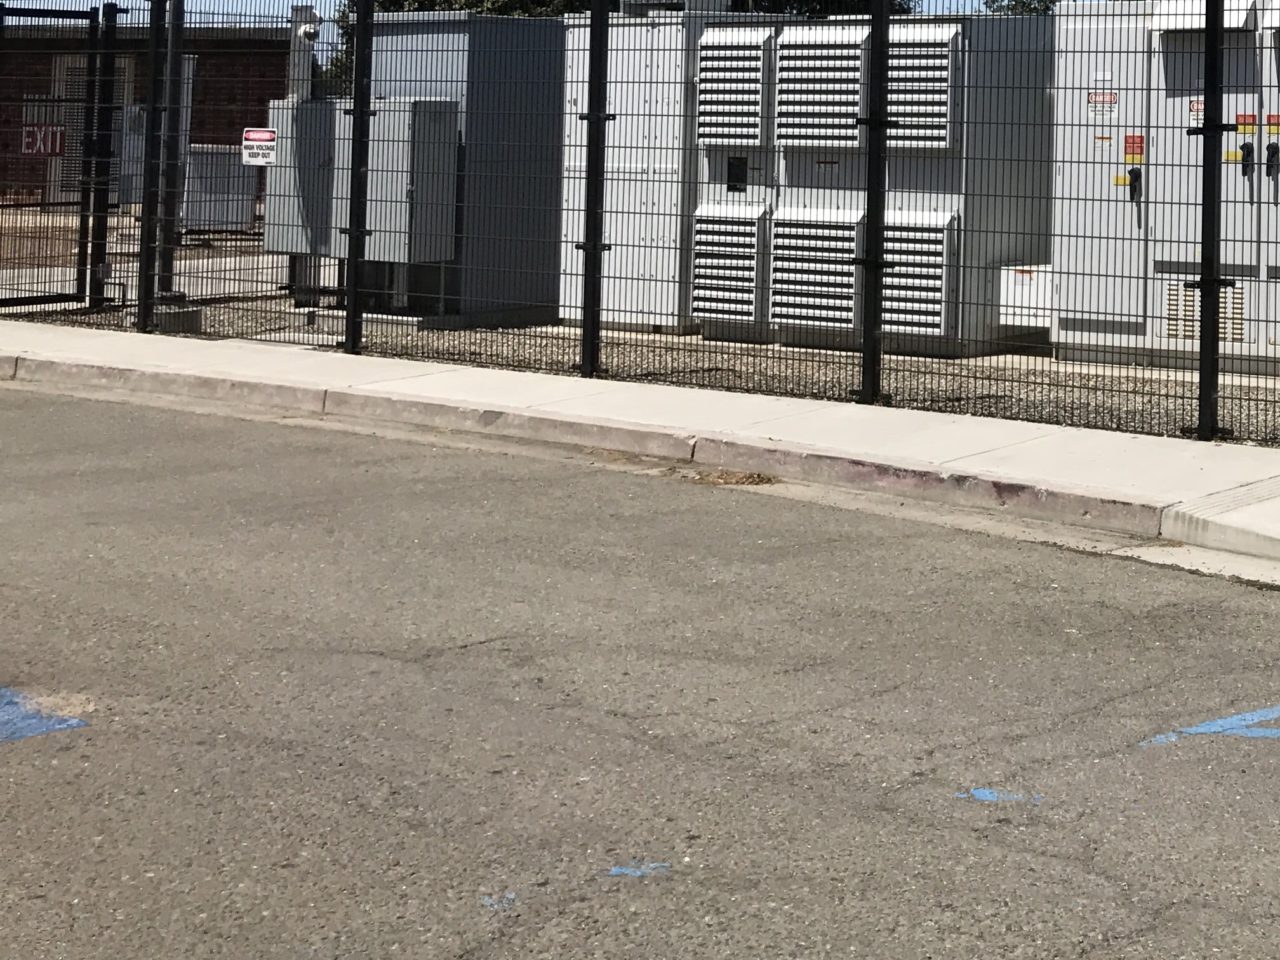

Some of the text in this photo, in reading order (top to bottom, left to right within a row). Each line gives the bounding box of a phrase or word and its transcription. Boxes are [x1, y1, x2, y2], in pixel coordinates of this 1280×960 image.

[22, 126, 65, 153] EXIT
[255, 144, 276, 152] VOLTAGE
[261, 151, 271, 159] OUT
